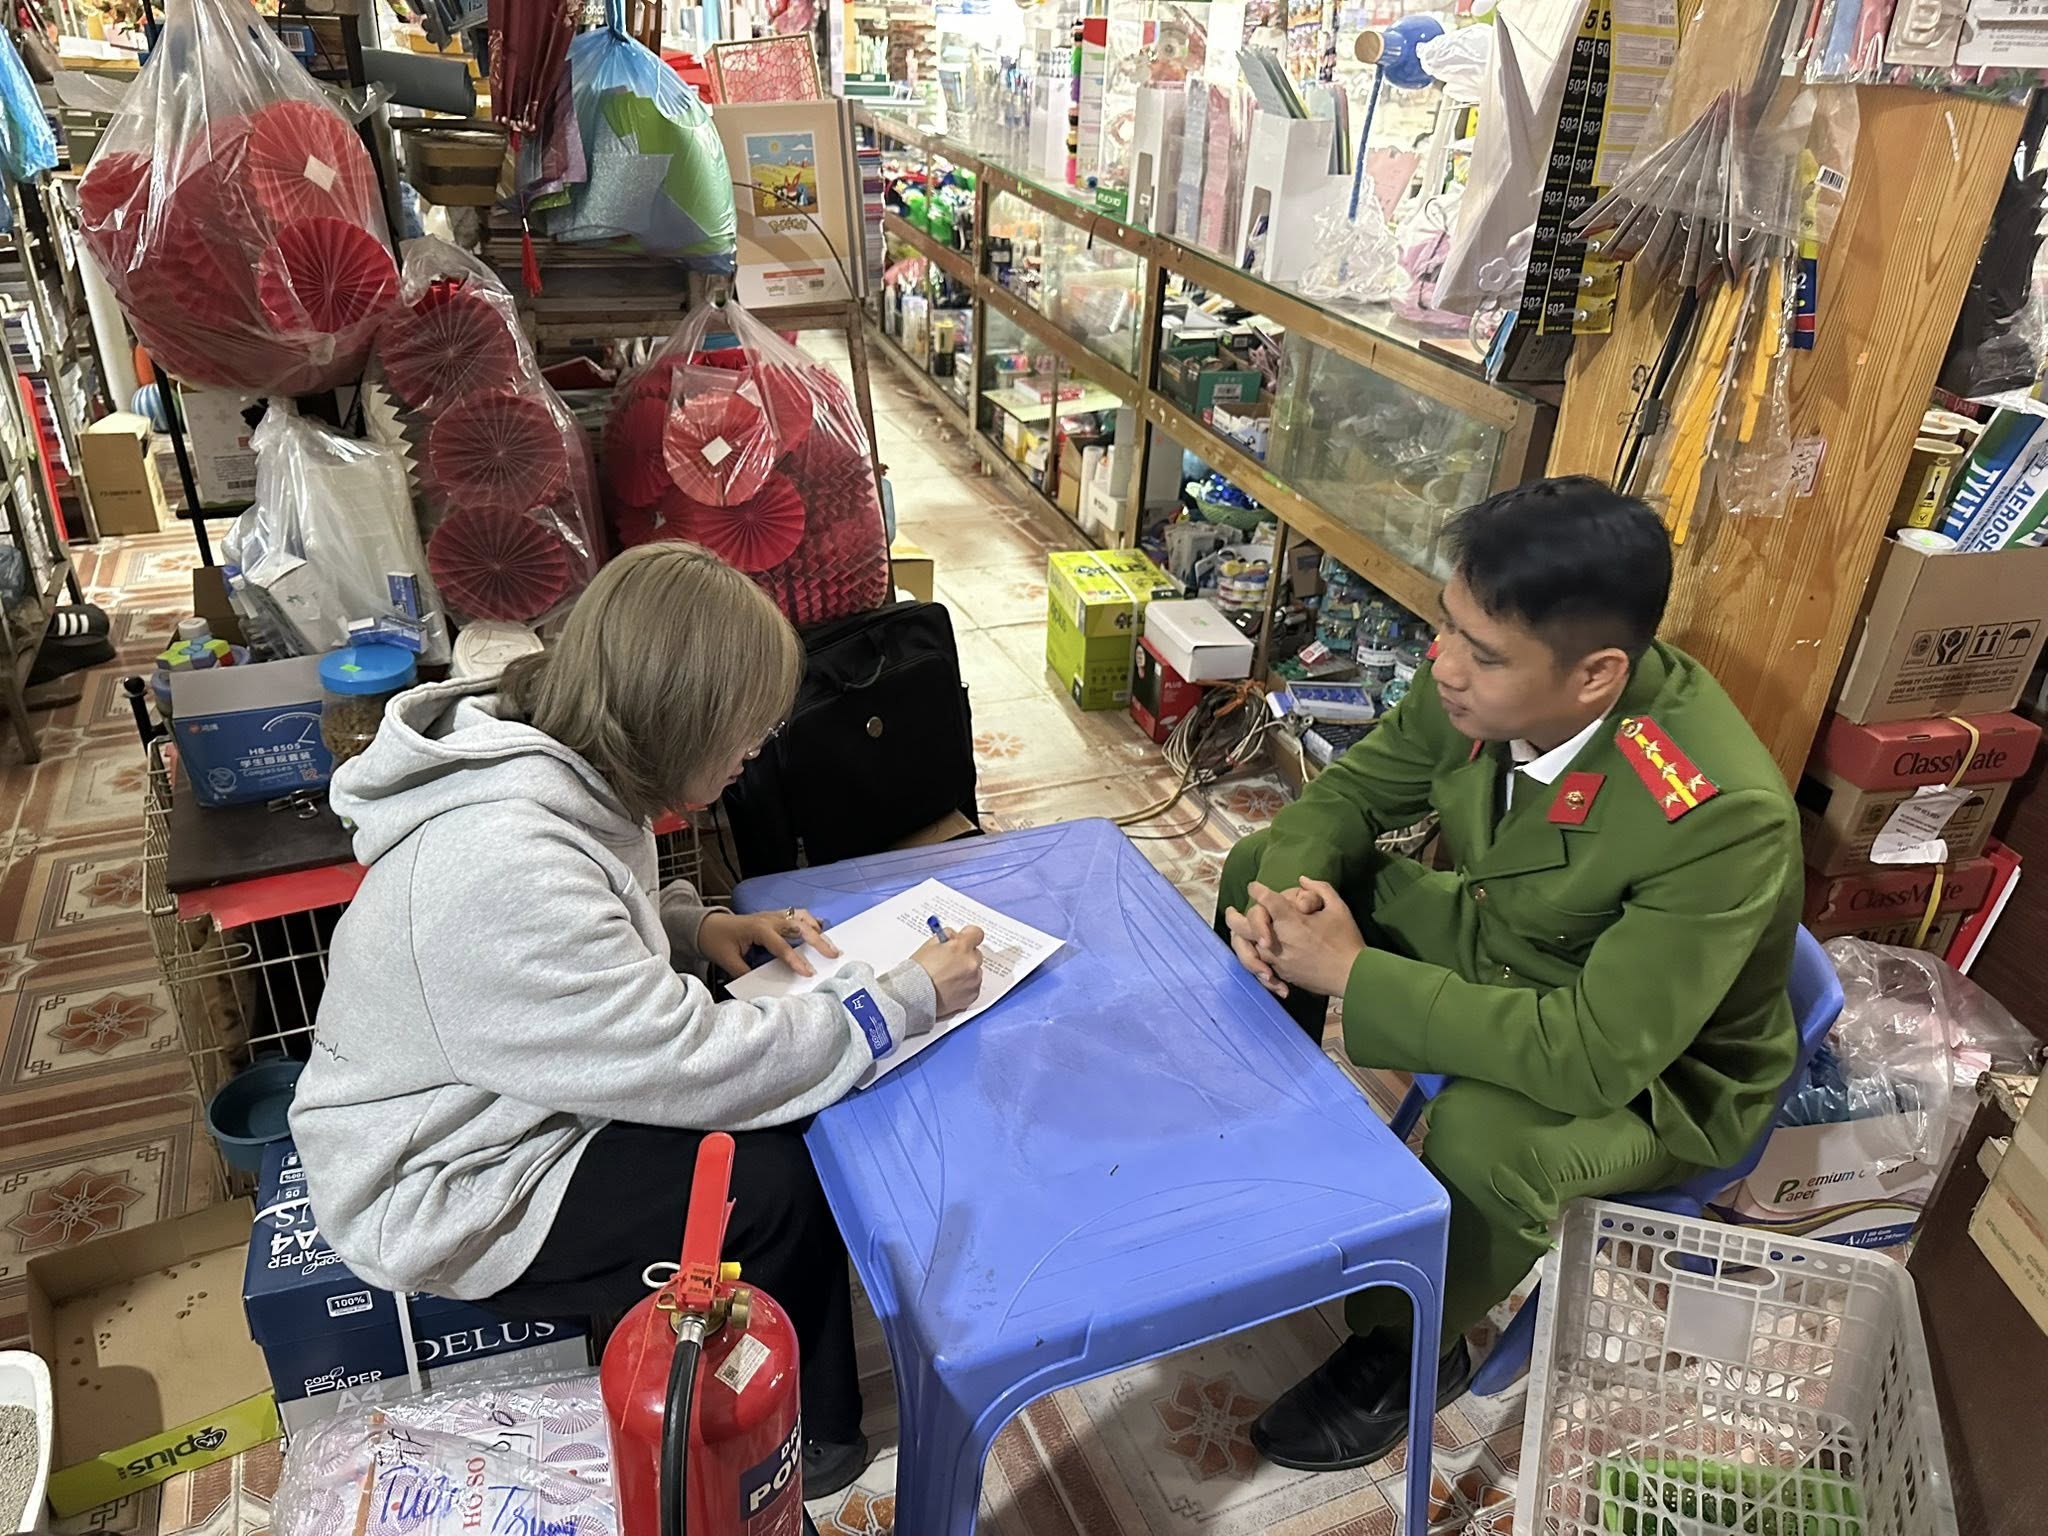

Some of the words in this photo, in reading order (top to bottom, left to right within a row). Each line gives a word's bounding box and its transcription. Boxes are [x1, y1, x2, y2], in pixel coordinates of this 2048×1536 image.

[1568, 79, 1587, 92] 502
[1559, 116, 1579, 130] 502
[1582, 121, 1601, 133] 502
[1551, 154, 1571, 168] 502
[1575, 159, 1593, 172] 502
[1543, 191, 1562, 204] 502
[1567, 196, 1585, 209] 502
[1536, 227, 1555, 240] 502
[1529, 262, 1548, 275] 502
[1552, 268, 1571, 280] 502
[1522, 297, 1541, 309] 502
[1546, 303, 1565, 315] 502
[270, 1226, 319, 1256] A4
[334, 1296, 366, 1309] 100%
[305, 1370, 382, 1397] PAPER
[336, 1383, 384, 1414] A4
[126, 1434, 204, 1478] plus
